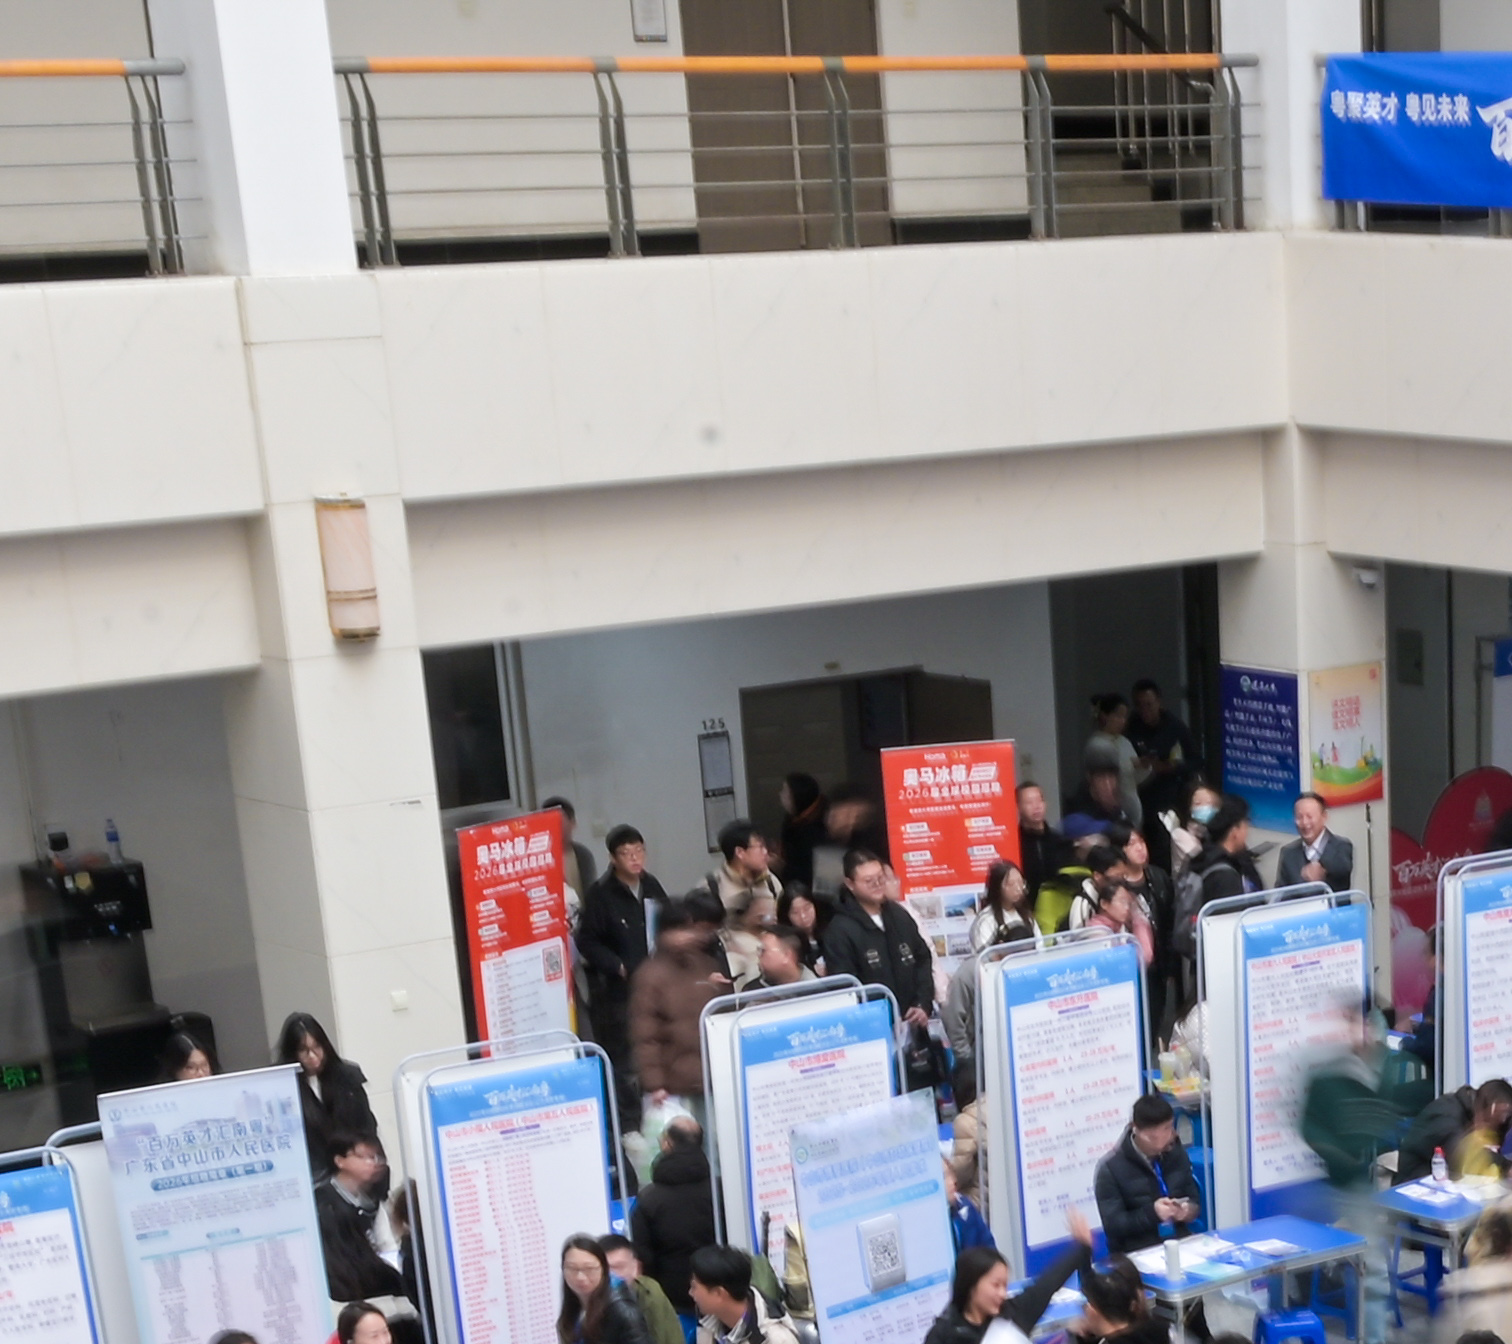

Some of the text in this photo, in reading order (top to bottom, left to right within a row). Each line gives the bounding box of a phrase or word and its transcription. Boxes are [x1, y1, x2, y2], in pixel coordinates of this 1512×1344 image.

[1330, 89, 1399, 125] 粤聚英才
[1405, 92, 1471, 126] 粤见未来
[701, 717, 725, 731] 125
[903, 764, 967, 787] 奥马冰箱
[476, 836, 527, 867] 奥马冰箱
[125, 1133, 292, 1176] 广东省中山市人民医院
